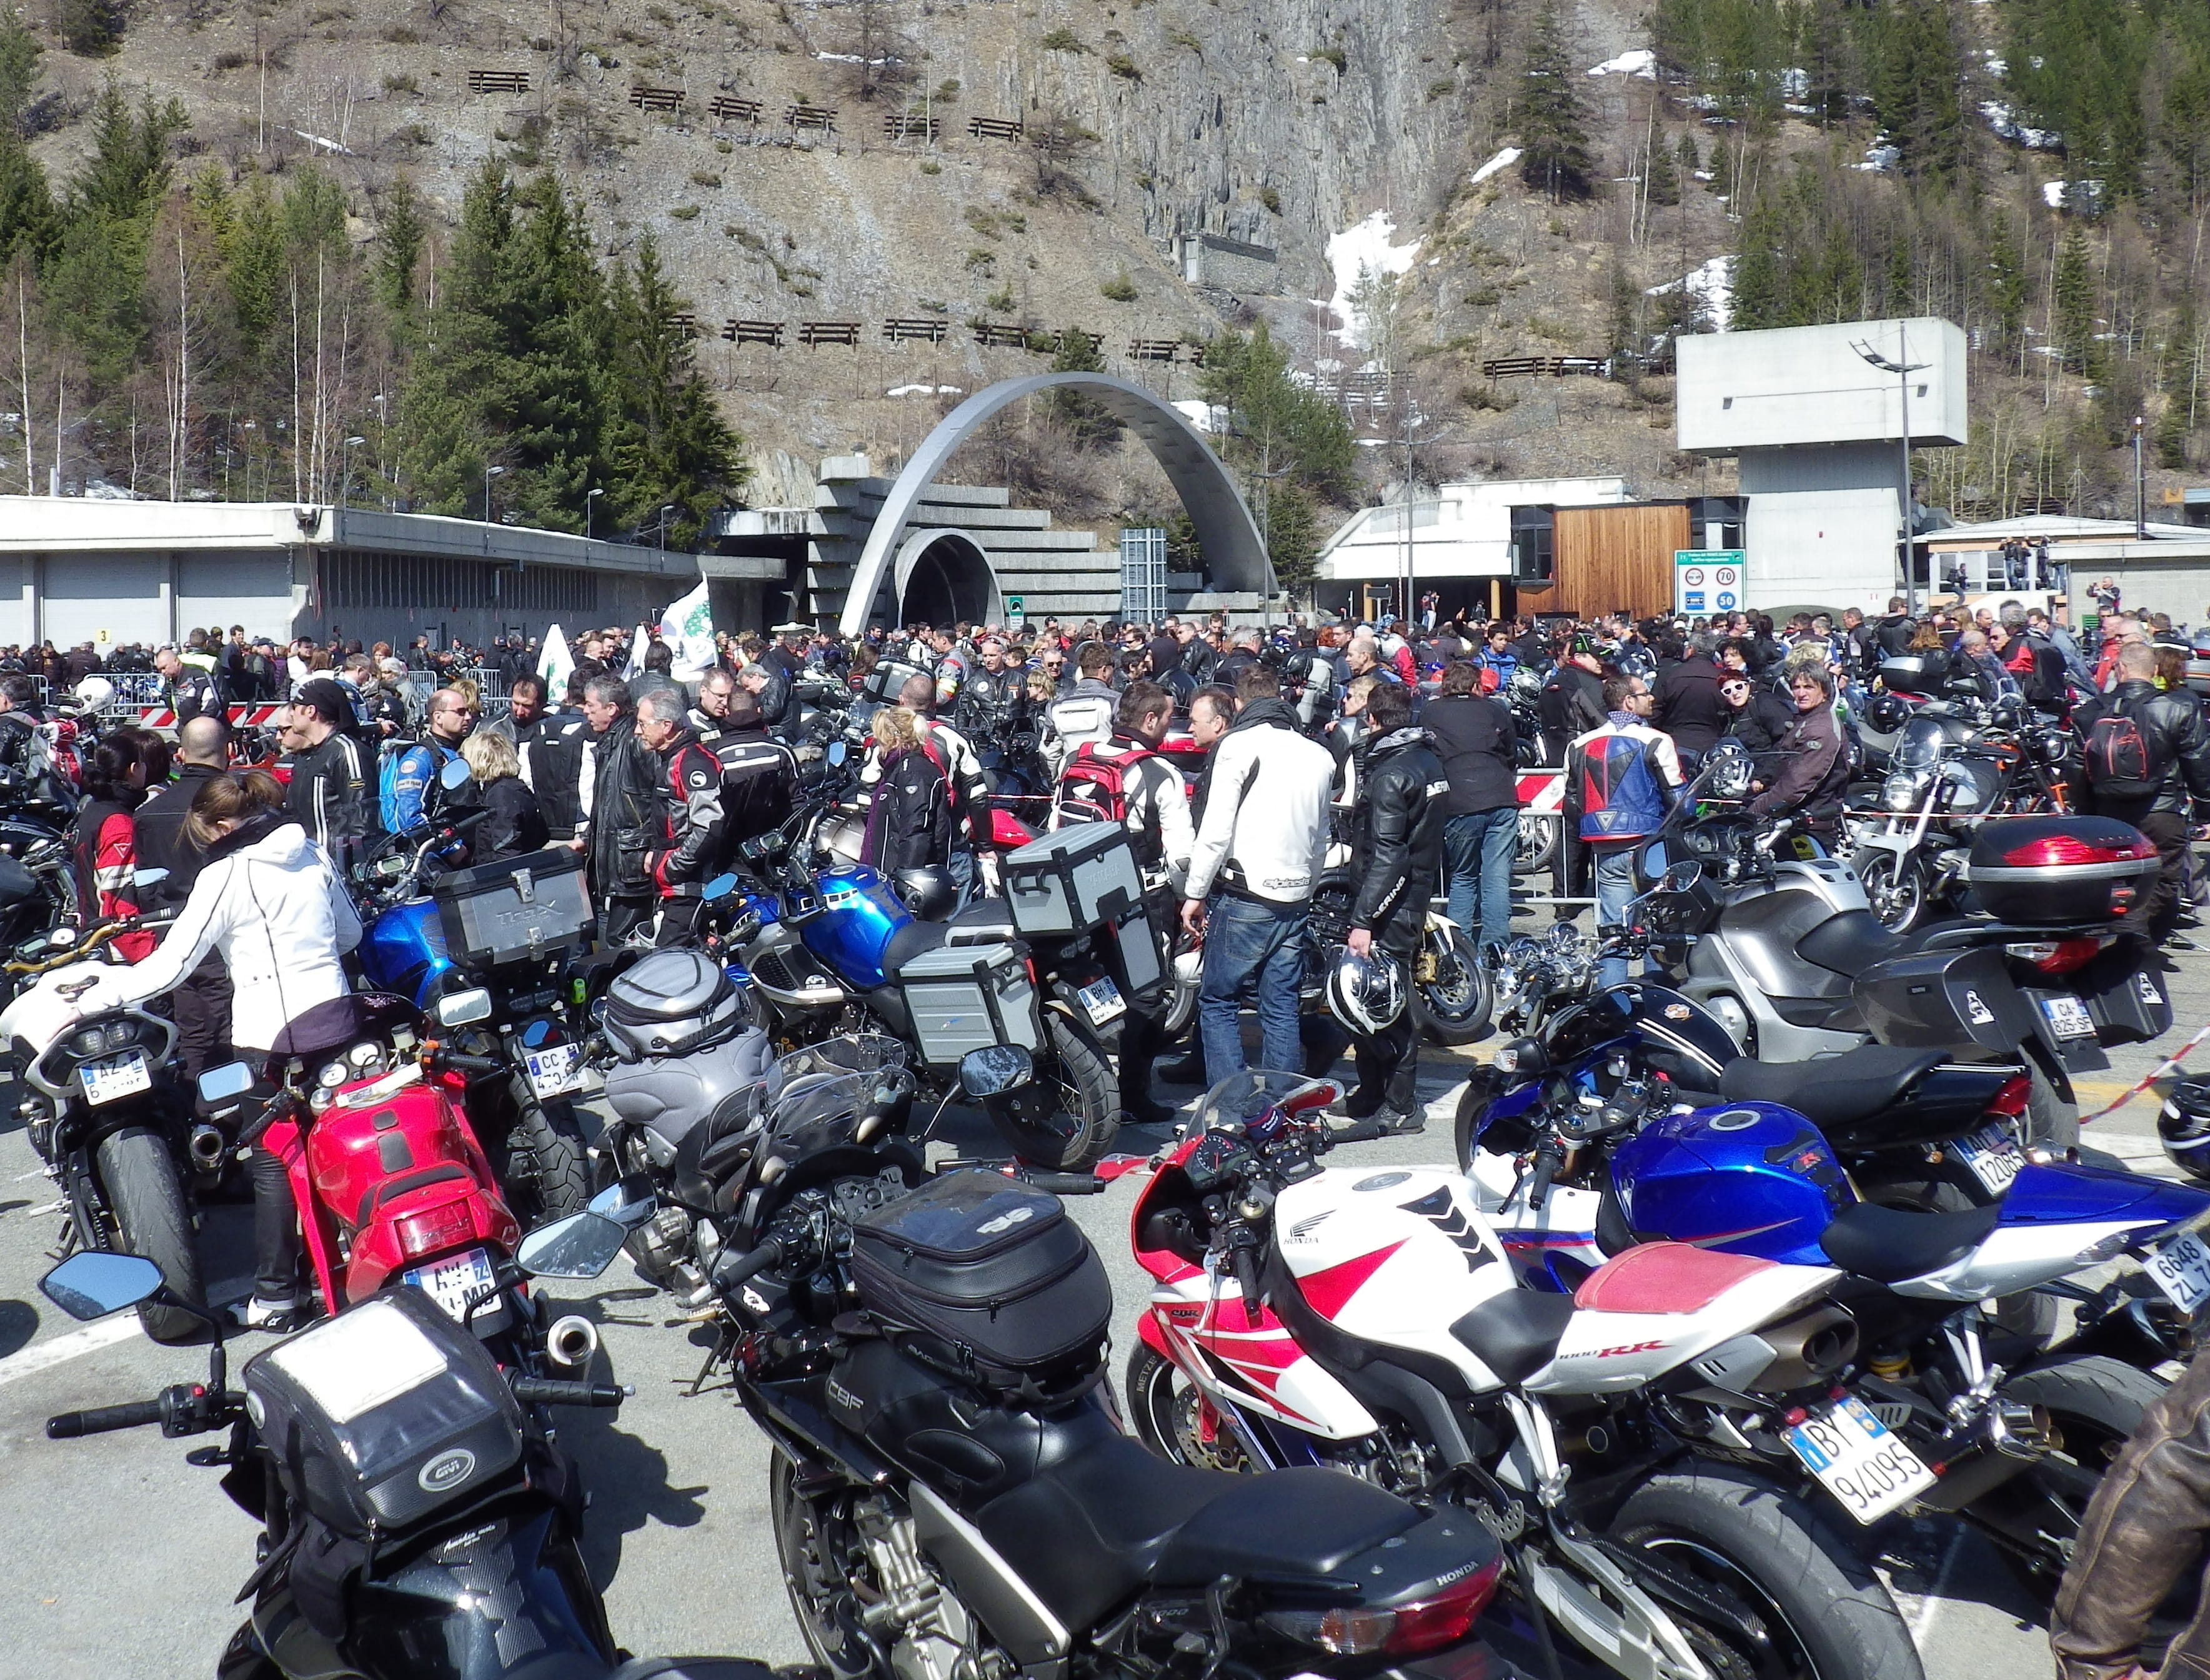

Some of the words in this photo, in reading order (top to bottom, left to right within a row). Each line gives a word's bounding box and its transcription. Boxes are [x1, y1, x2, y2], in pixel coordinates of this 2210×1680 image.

[1721, 572, 1732, 581] 70
[1720, 596, 1733, 606] 50
[101, 630, 106, 642] 3
[2053, 1016, 2090, 1033] 825-SF
[1979, 1147, 2027, 1186] 12085
[1284, 1237, 1318, 1245] HONDA
[2157, 1240, 2201, 1280] 6648
[2171, 1278, 2204, 1305] ZL
[1136, 1355, 1157, 1393] METZE
[829, 1379, 864, 1409] CBF
[1806, 1413, 1854, 1458] BY
[1834, 1441, 1922, 1509] 94095
[1435, 1560, 1479, 1586] HONDA
